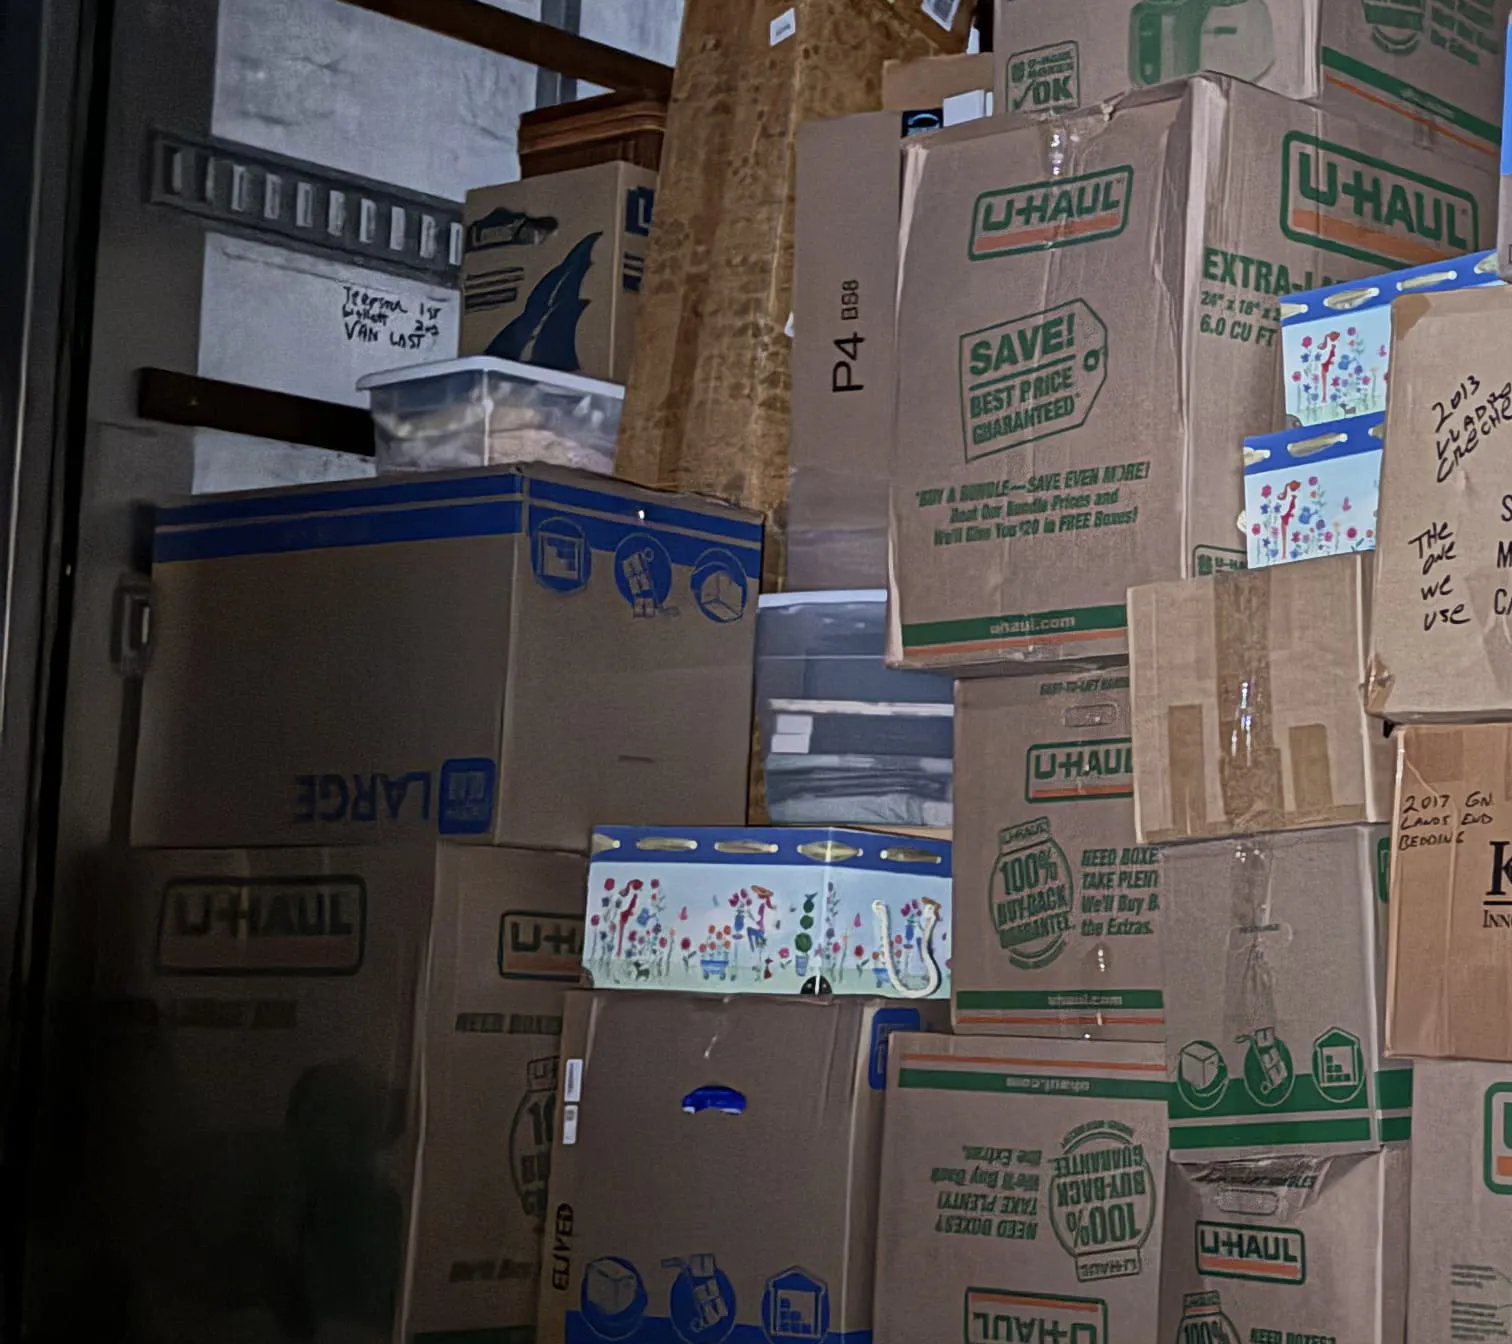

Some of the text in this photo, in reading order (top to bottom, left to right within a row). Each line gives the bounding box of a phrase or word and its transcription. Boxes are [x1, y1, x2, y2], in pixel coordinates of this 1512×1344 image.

[1032, 75, 1074, 105] OK
[982, 179, 1121, 232] U-HAUL
[1298, 150, 1469, 251] U-HAUL
[344, 319, 426, 349] VAN LAST
[969, 313, 1076, 377] SAVE!
[1200, 313, 1280, 348] 6.0 CU FT
[832, 331, 865, 393] P4
[970, 366, 1073, 419] BEST PRICE
[1431, 375, 1480, 433] 2013
[1064, 468, 1099, 488] EVEN
[1058, 513, 1091, 532] FREE
[295, 771, 432, 821] LARGE
[1403, 794, 1450, 814] 2017
[1001, 848, 1057, 895] 100%
[1081, 873, 1115, 890] TAKE
[1118, 895, 1144, 915] Buy
[1057, 1170, 1146, 1207] BUY-BACK
[1065, 1203, 1142, 1248] 100%
[1200, 1230, 1298, 1263] U-HAUL
